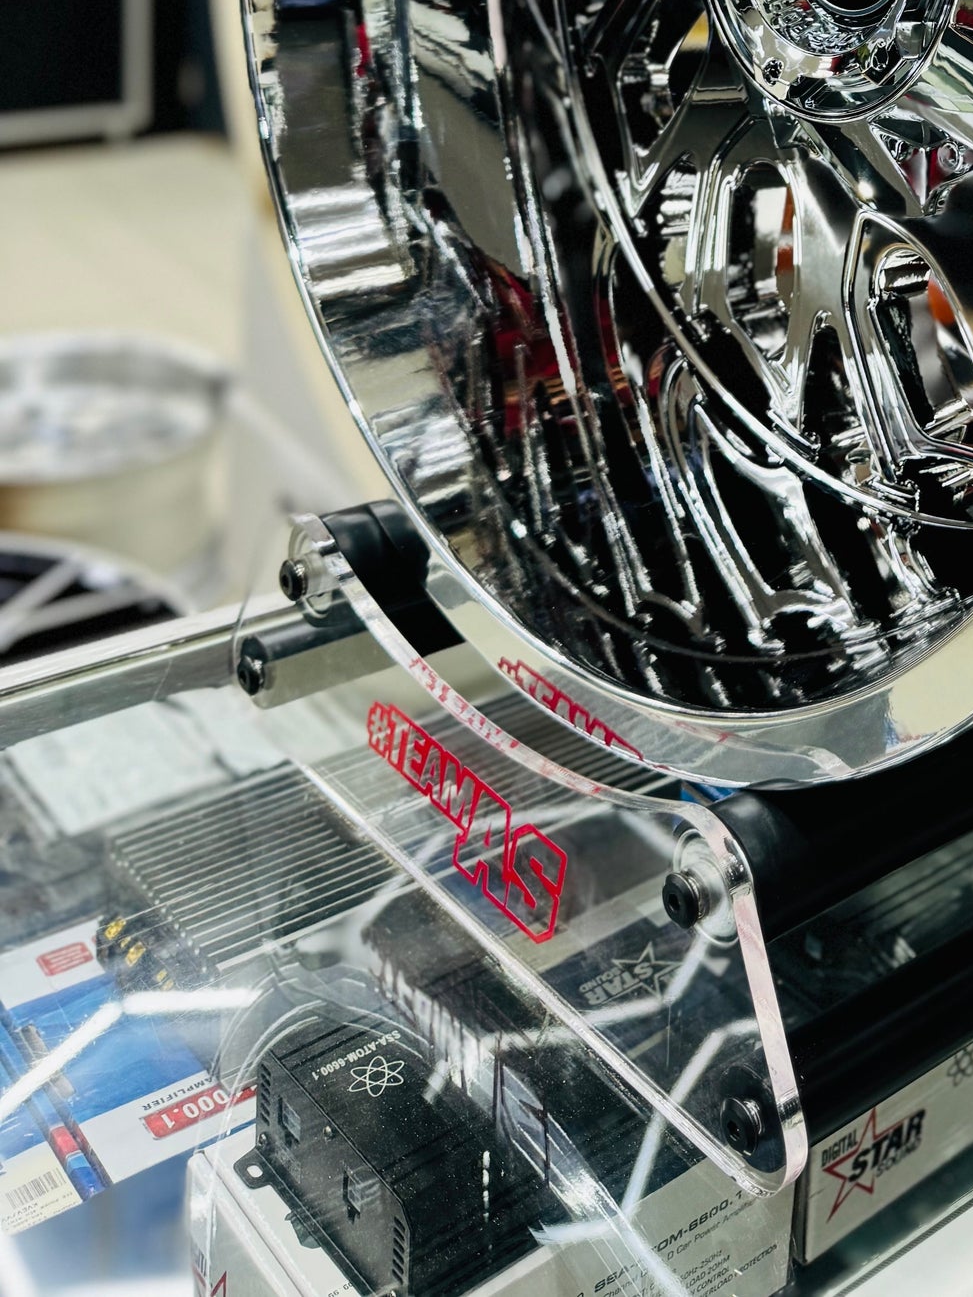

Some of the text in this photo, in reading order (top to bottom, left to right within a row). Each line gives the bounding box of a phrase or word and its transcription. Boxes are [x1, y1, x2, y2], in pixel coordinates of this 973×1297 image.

[584, 962, 654, 1006] STAR
[311, 1030, 401, 1081] SSA-ATOM-6600.1
[821, 1129, 859, 1168] DIGITAL
[848, 1108, 927, 1183] STAR
